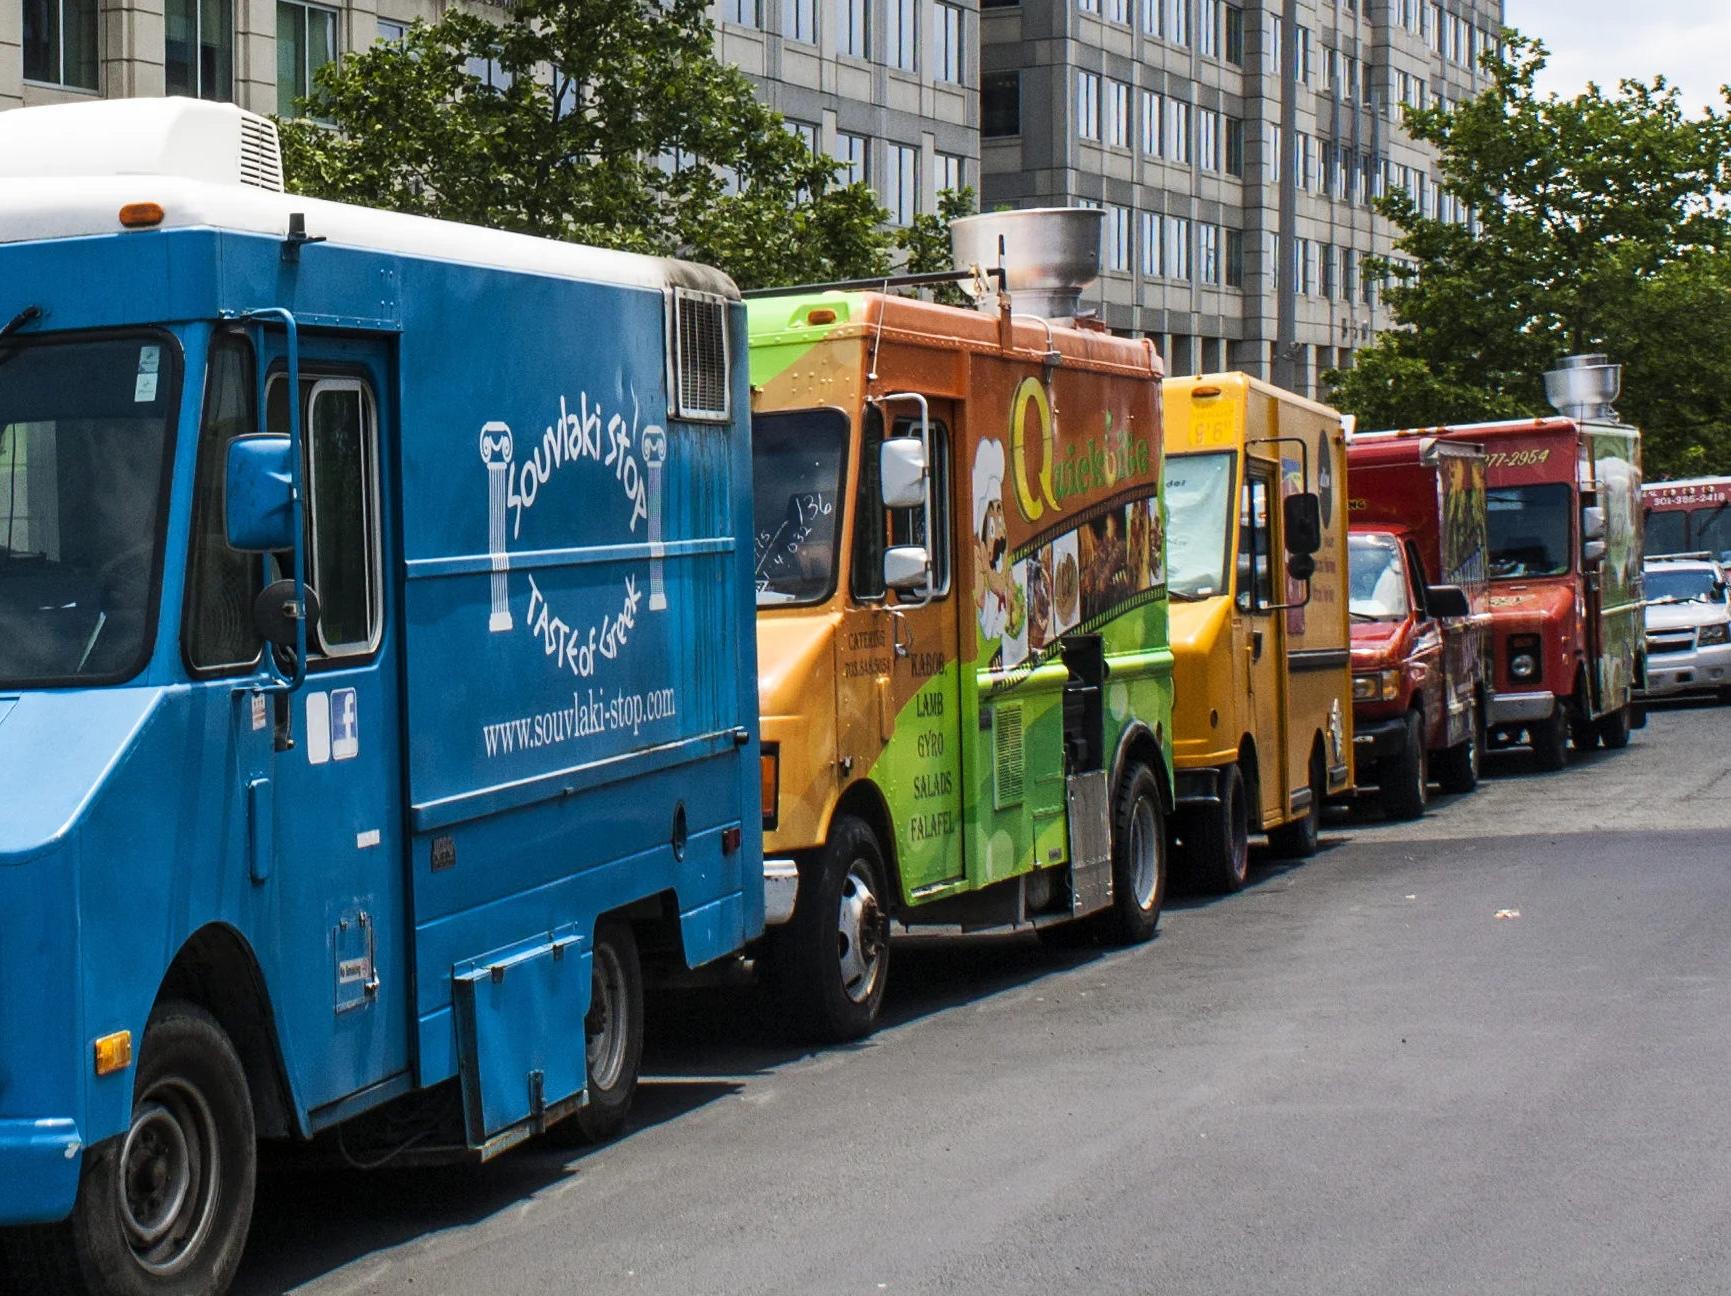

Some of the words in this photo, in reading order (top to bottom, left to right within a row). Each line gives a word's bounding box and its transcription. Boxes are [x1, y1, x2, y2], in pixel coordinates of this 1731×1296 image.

[916, 691, 943, 717] LAMB
[483, 687, 676, 758] www.souvlaki-stop.com
[917, 730, 944, 758] GYRO
[913, 771, 952, 800] SALADS
[910, 810, 955, 842] FALAFEL
